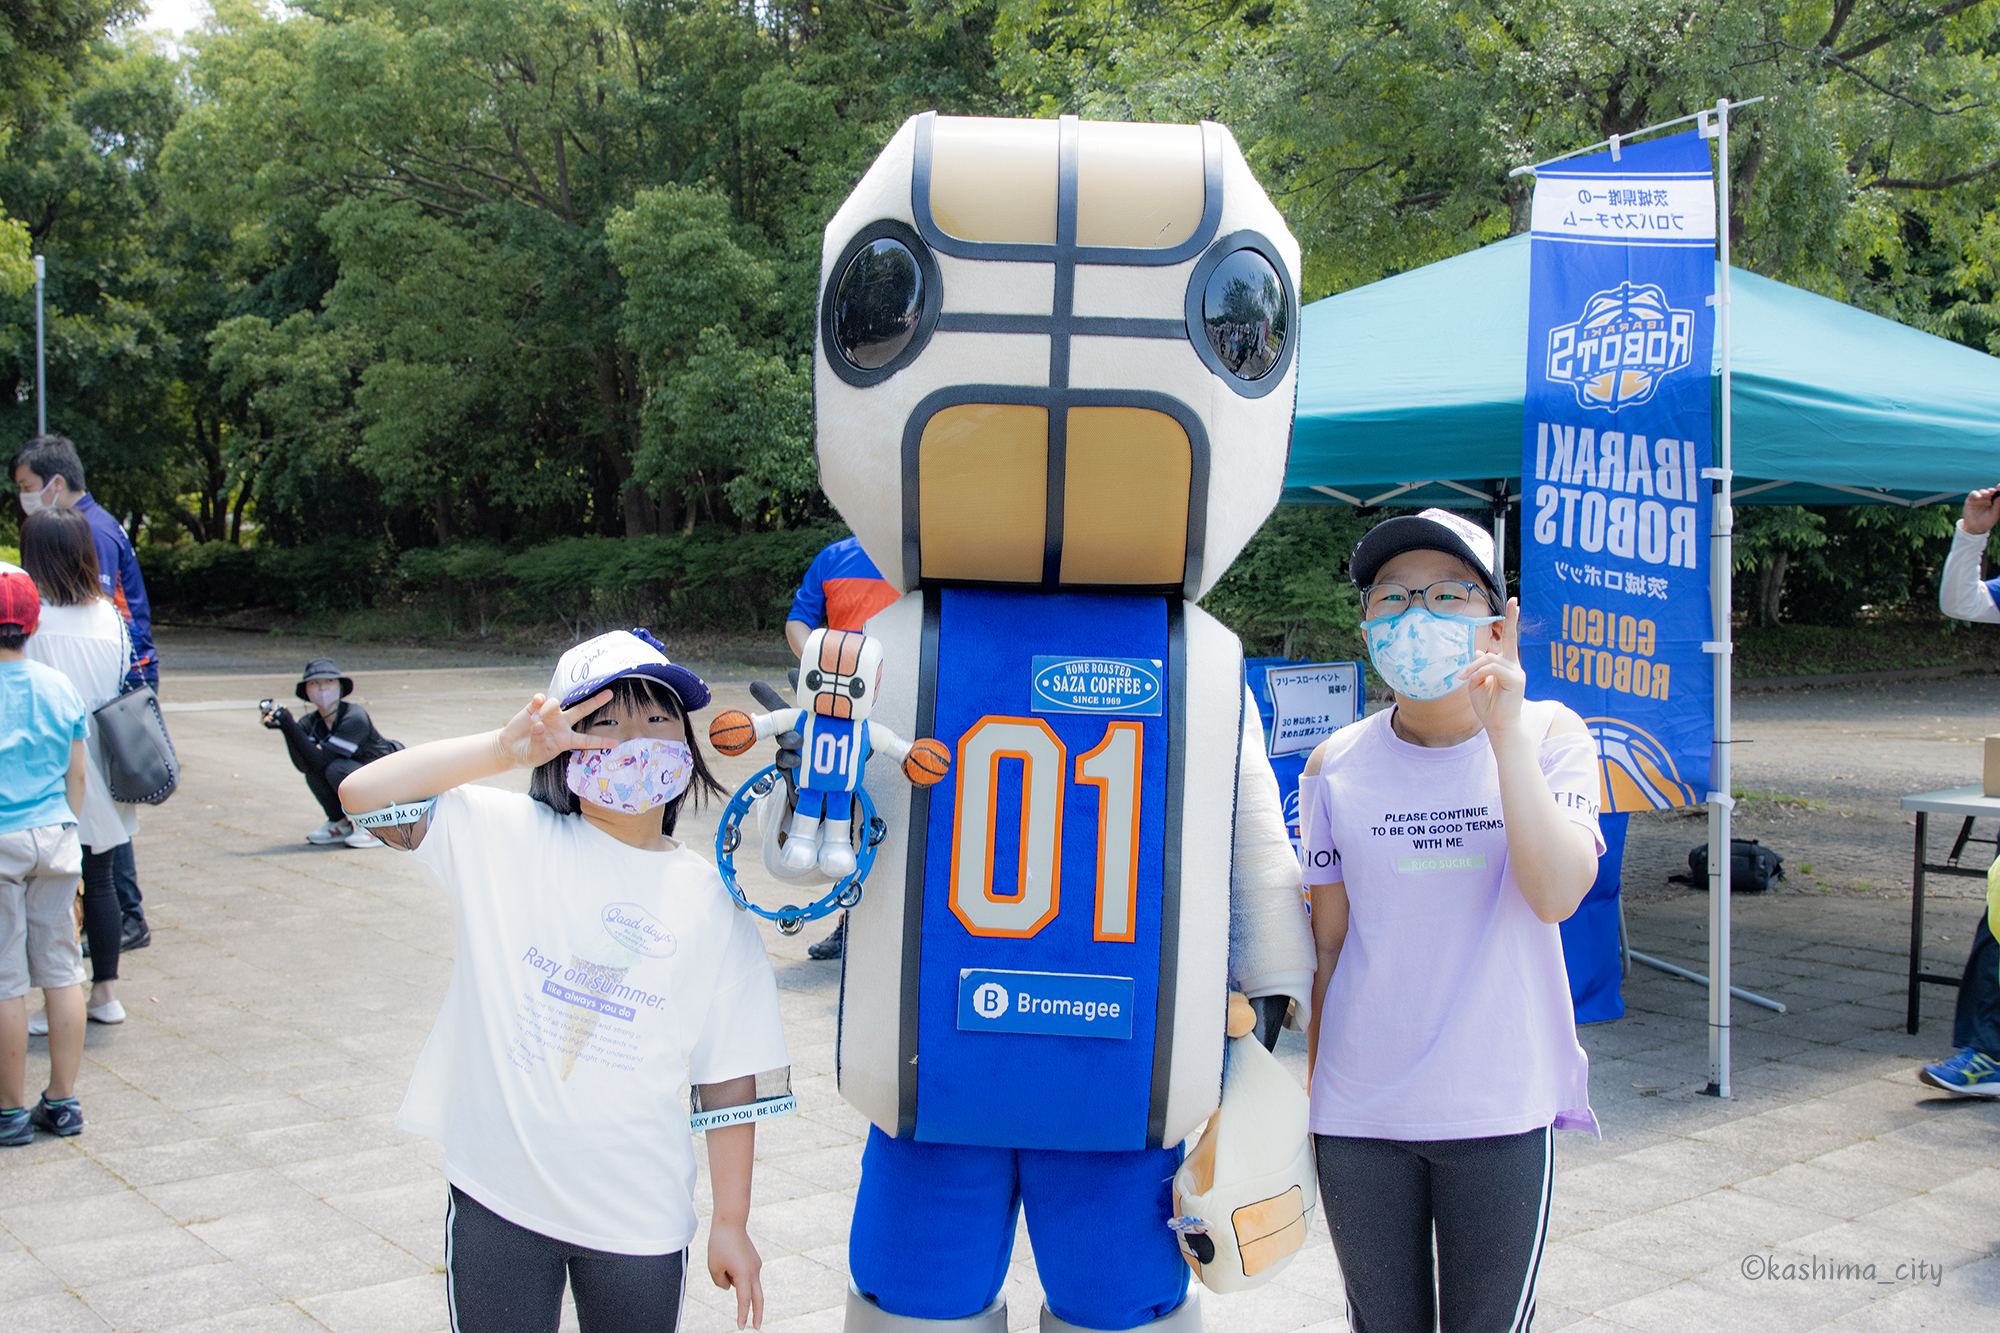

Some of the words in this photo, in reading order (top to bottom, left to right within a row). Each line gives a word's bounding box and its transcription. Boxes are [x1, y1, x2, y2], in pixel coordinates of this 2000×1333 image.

[1065, 663, 1090, 675] HOME
[1092, 663, 1131, 678] ROASTED
[1052, 675, 1086, 693] SAZA
[1090, 677, 1141, 695] COFFEE
[1275, 673, 1340, 686] フリースローイベント
[1072, 695, 1099, 704] SINCE
[1101, 696, 1121, 705] 1969
[814, 733, 849, 776] 01
[1384, 813, 1428, 823] PLEASE
[1430, 807, 1489, 821] CONTINUE
[948, 715, 1144, 943] 01
[1371, 826, 1386, 836] TO
[1389, 826, 1404, 836] BE
[1407, 825, 1425, 836] ON
[1428, 824, 1463, 835] GOOD
[1465, 819, 1504, 832] TERMS
[1412, 838, 1442, 850] WITH
[1446, 837, 1464, 848] ME
[1411, 859, 1437, 870] RICO
[1439, 858, 1473, 869] SUCRE
[522, 946, 563, 979] Razy
[563, 968, 588, 986] on
[588, 976, 667, 1011] summer.
[546, 982, 562, 997] like
[564, 989, 597, 1009] always
[599, 1002, 617, 1013] you
[618, 1006, 631, 1018] do
[983, 989, 999, 1012] B
[1017, 991, 1121, 1021] Bromagee
[597, 1022, 612, 1031] and
[613, 1026, 634, 1039] strong
[599, 1034, 627, 1047] towards
[606, 1049, 645, 1063] understand
[732, 1110, 753, 1121] YOU
[756, 1107, 768, 1116] BE
[770, 1101, 793, 1114] LUCKY
